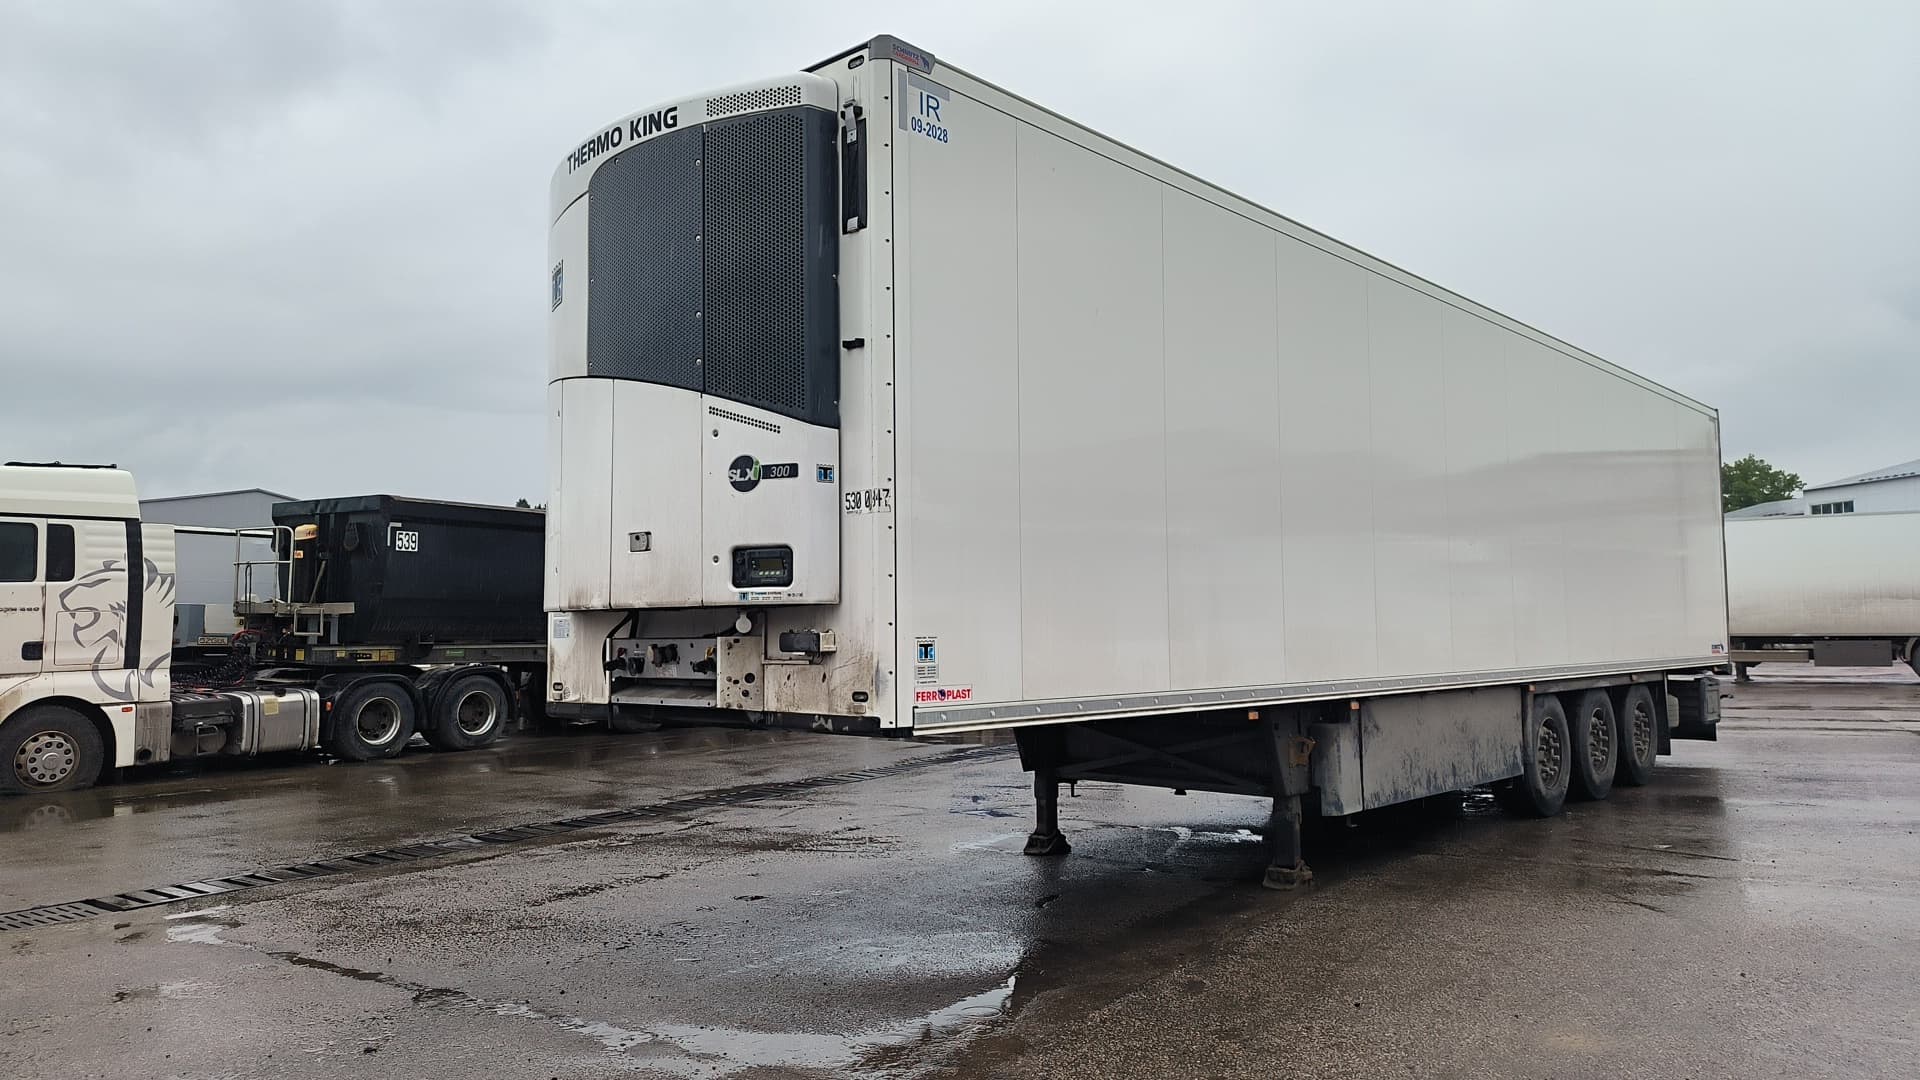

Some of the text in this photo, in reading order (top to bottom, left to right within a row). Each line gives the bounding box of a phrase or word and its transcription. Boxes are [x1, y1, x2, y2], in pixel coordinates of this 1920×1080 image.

[919, 91, 941, 122] IR
[911, 116, 948, 143] 09-2028
[567, 106, 678, 175] THERMO KING
[770, 465, 790, 478] 300
[845, 491, 862, 510] 530
[397, 532, 417, 551] 539
[915, 688, 972, 702] FERROPLAST
